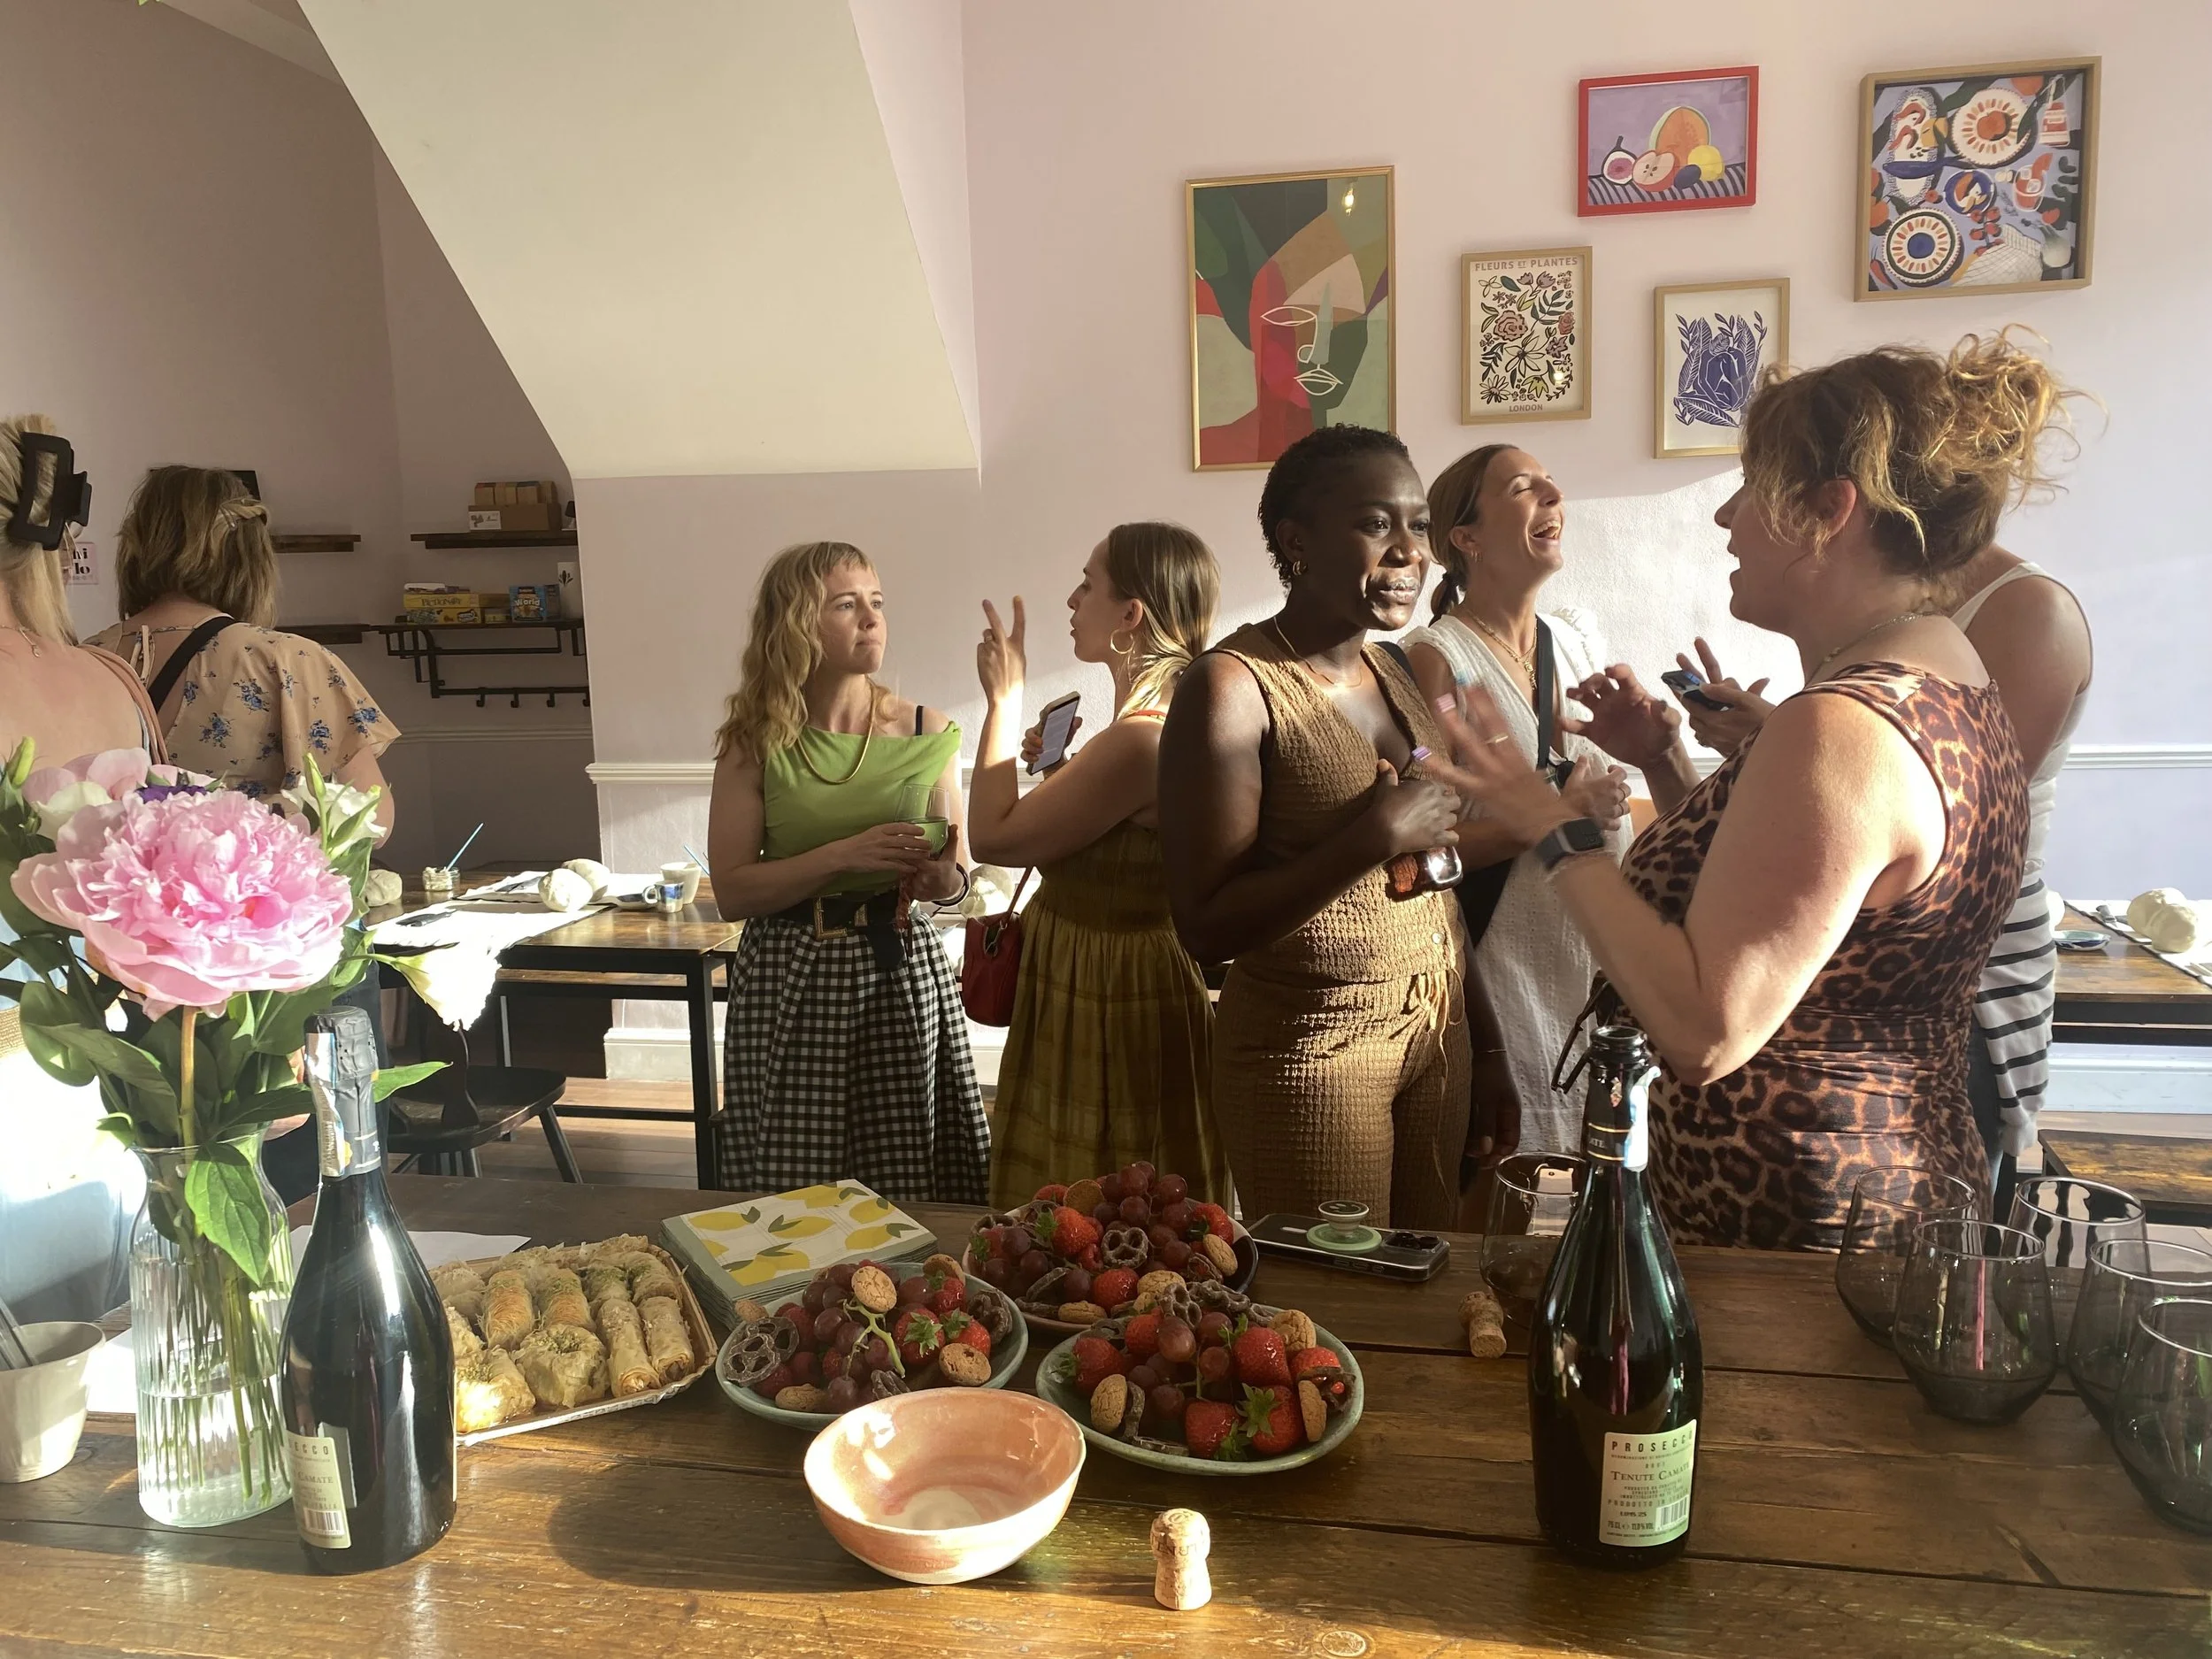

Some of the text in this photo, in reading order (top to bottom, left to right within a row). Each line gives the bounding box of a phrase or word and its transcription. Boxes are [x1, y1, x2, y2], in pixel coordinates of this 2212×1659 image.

[1475, 261, 1514, 272] FLEURS
[1531, 257, 1578, 268] PLANTES
[1610, 1471, 1655, 1481] TENUTE
